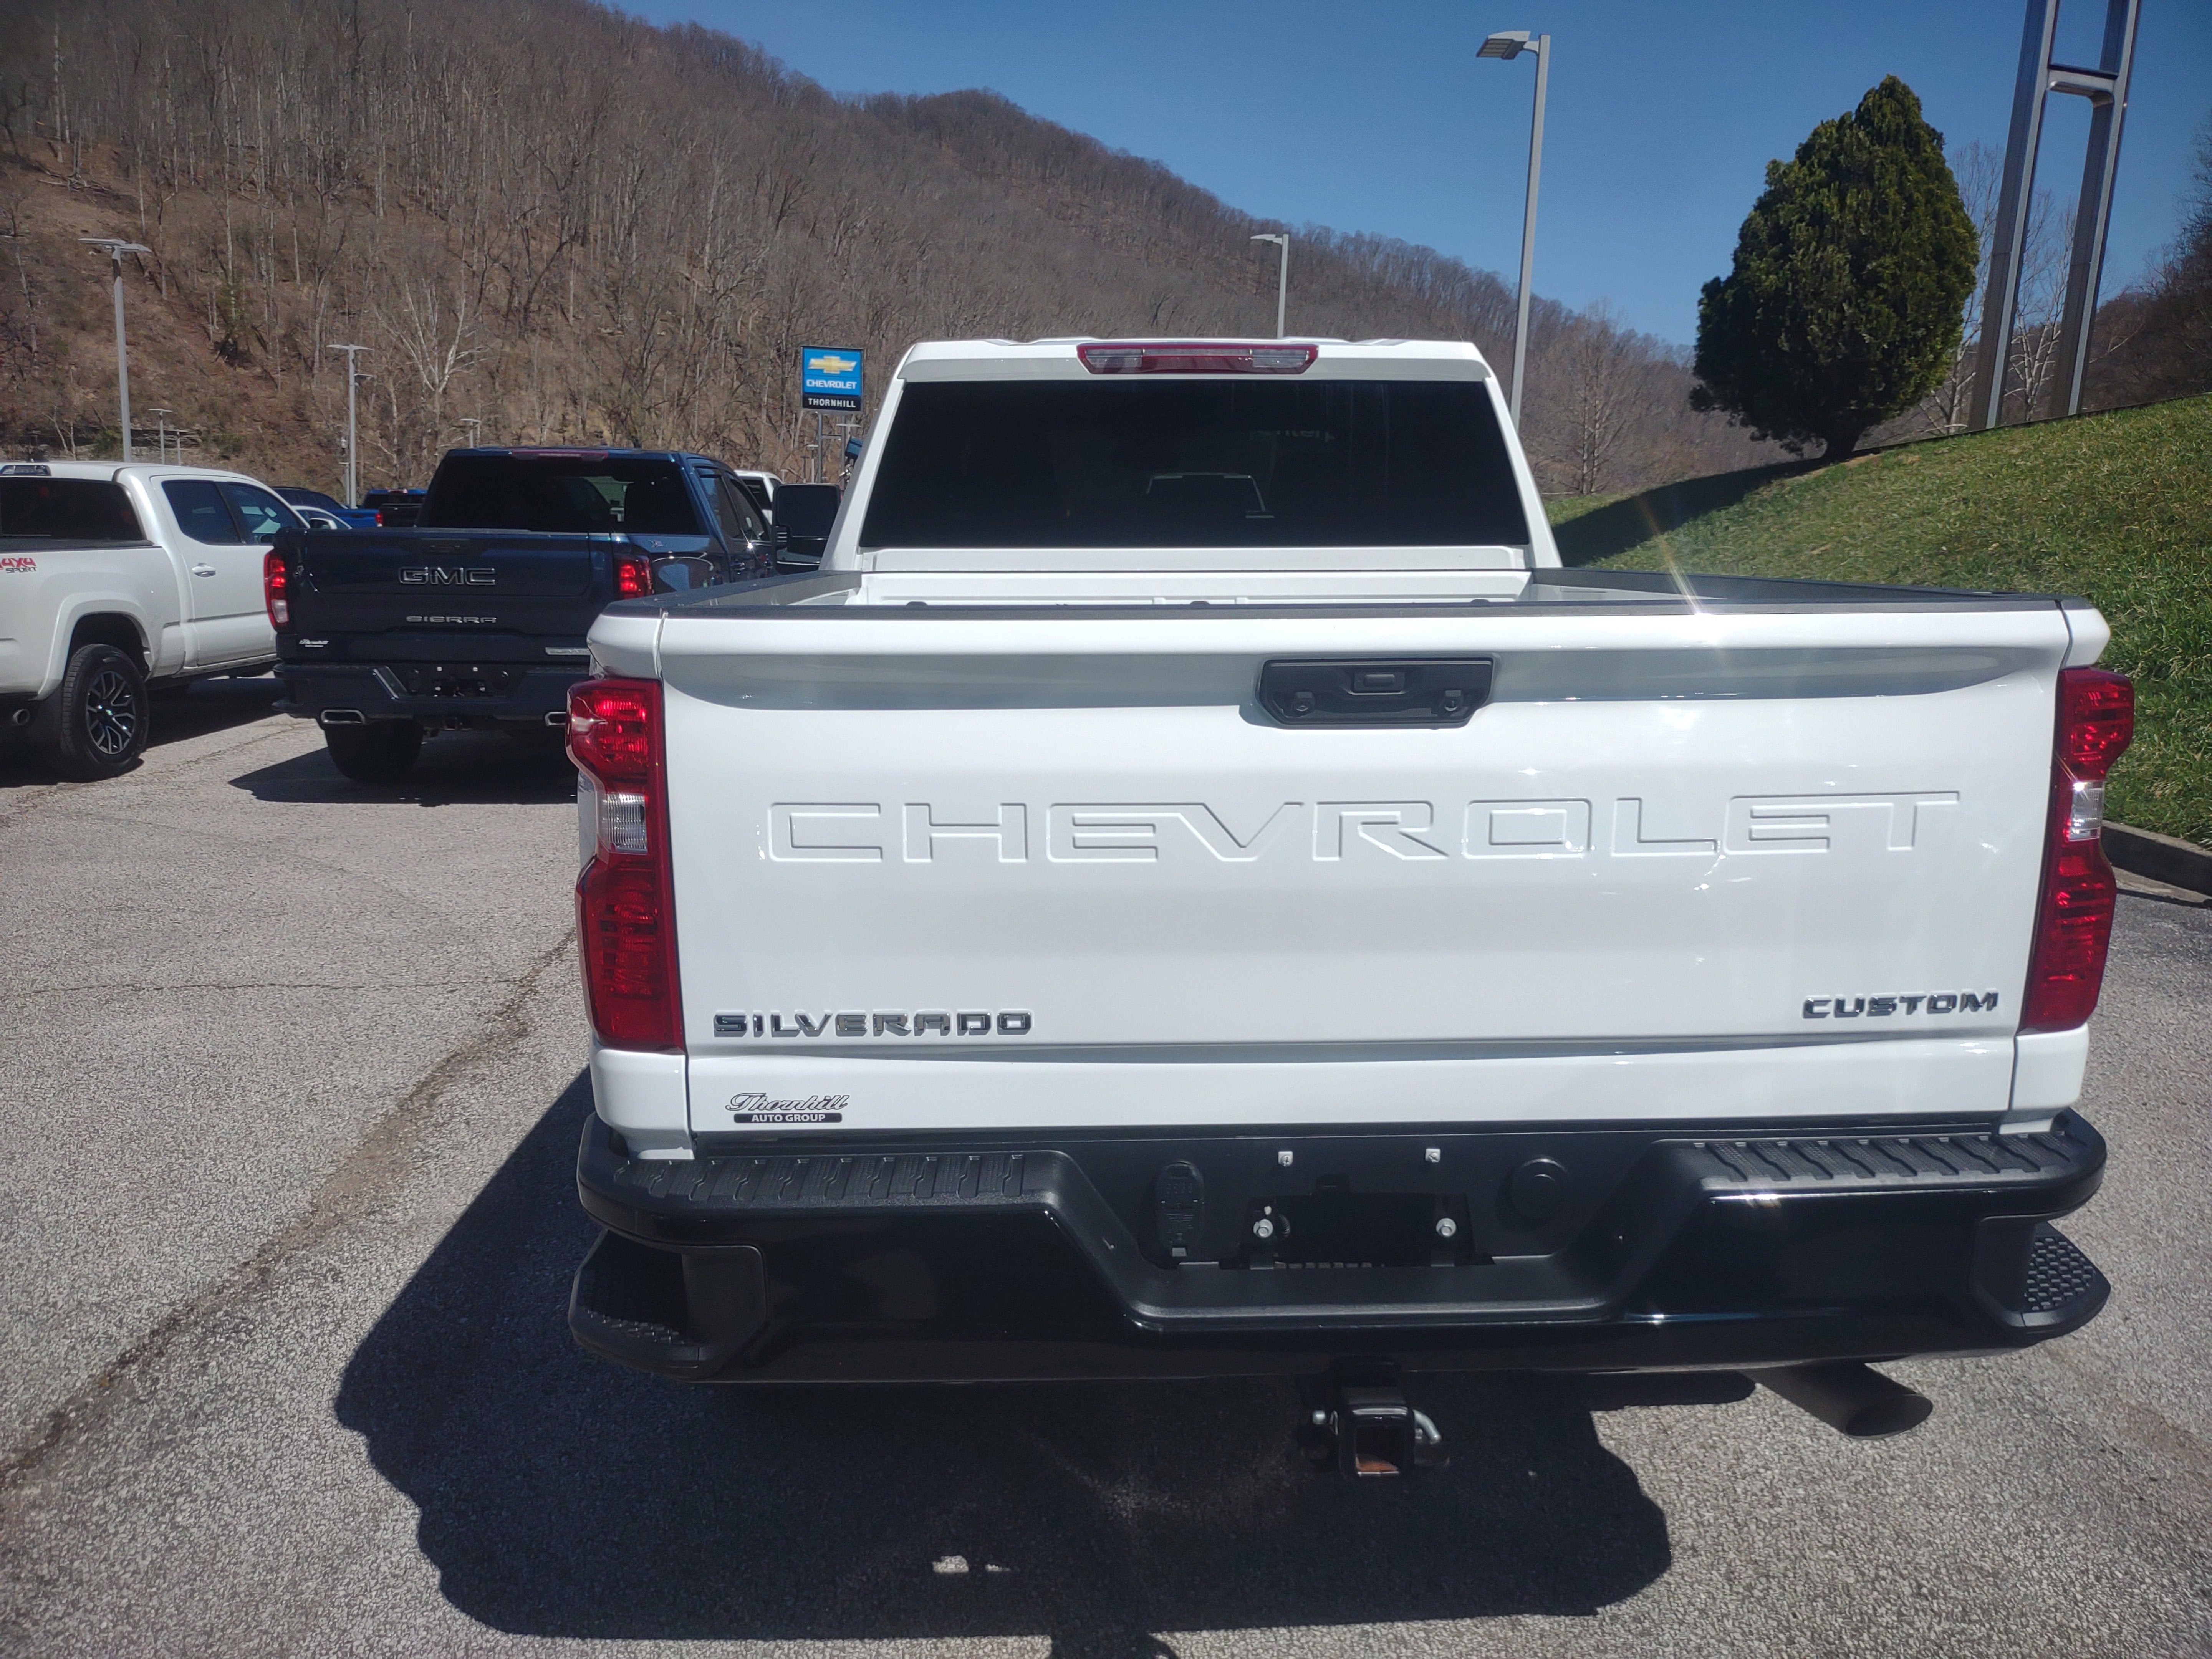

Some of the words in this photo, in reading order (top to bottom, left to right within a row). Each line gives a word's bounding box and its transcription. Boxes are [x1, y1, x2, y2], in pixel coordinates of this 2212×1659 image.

[807, 379, 857, 389] CHEVROLET
[808, 398, 856, 408] THORNHILL
[399, 566, 496, 585] GMC
[767, 790, 1960, 863] CHEVROLET
[1803, 991, 1999, 1018] CUSTOM
[714, 1012, 1032, 1036] SILVERADO
[725, 1092, 850, 1111] Thornhill
[751, 1114, 783, 1123] AUTO
[785, 1114, 826, 1122] GROUP
